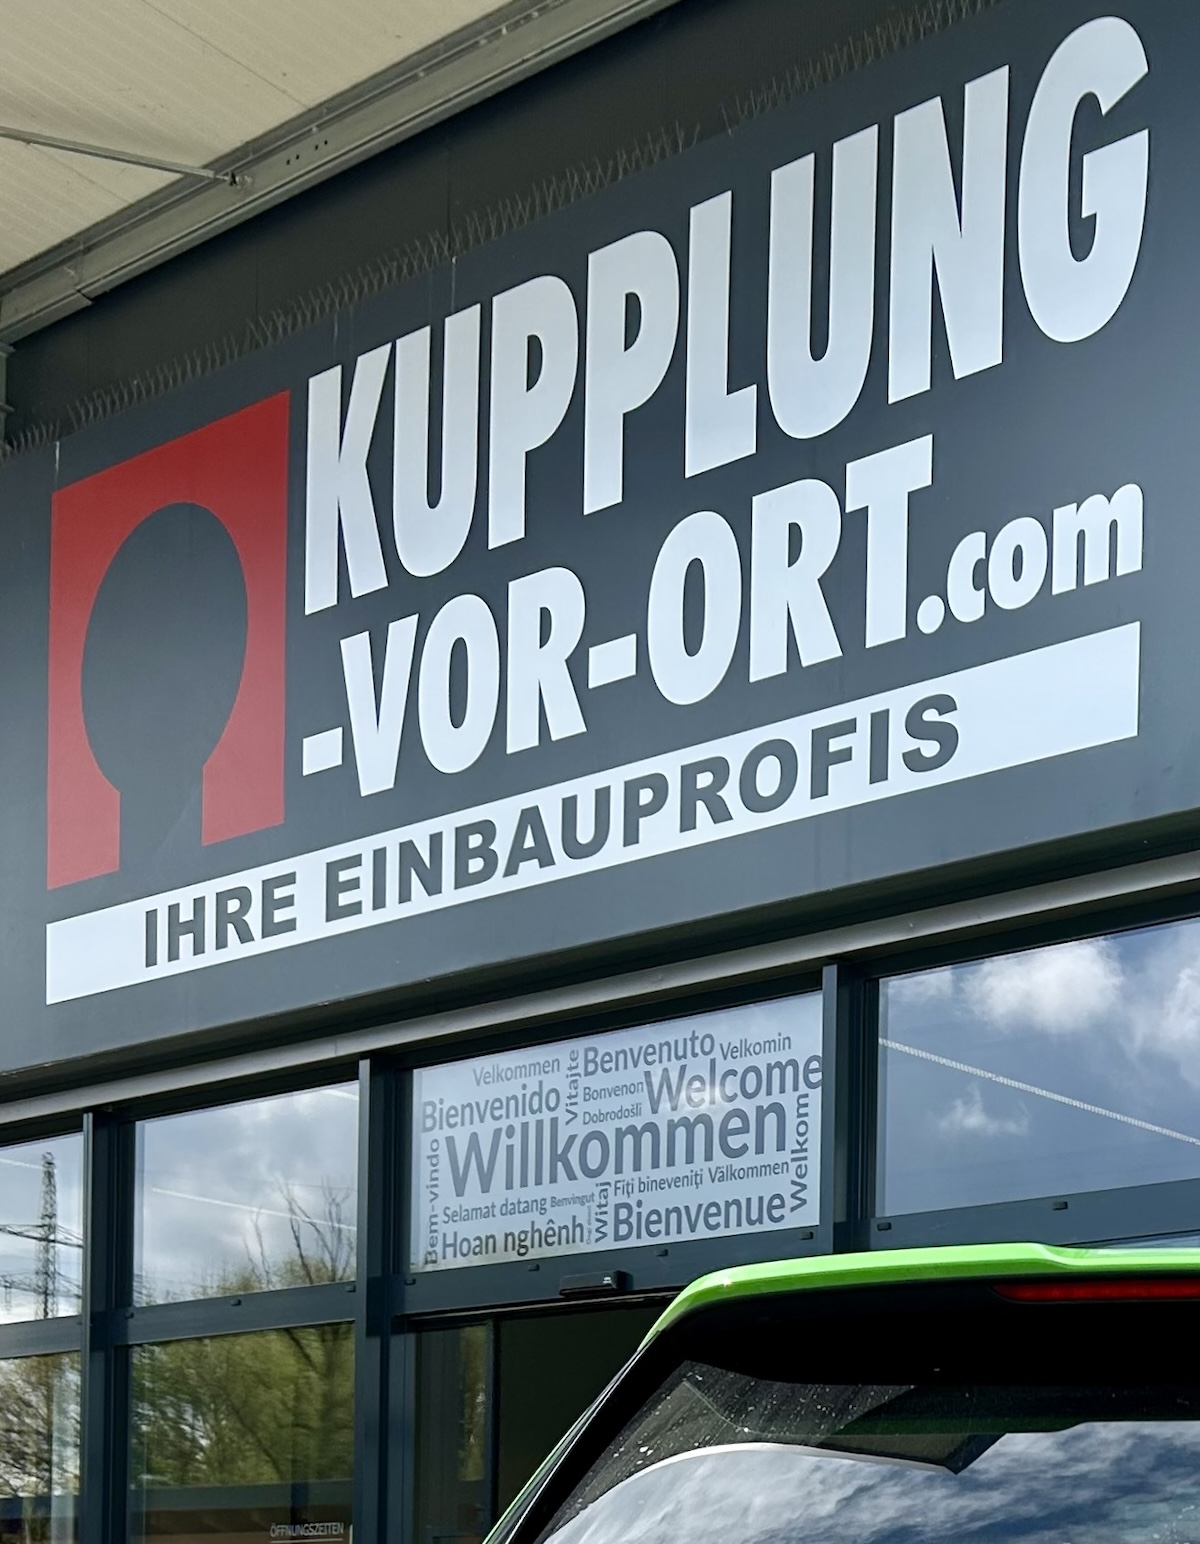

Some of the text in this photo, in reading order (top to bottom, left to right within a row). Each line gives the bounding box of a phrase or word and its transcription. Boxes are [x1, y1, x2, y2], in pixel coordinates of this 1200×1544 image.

[303, 15, 1150, 616] KUPPLUNG
[301, 434, 1144, 797] -VOR-ORT.com
[142, 692, 960, 968] IHRE EINBAUPROFIS
[584, 1030, 715, 1077] Benvenuto
[720, 1032, 792, 1060] Velkomin
[473, 1058, 560, 1087] Velkommen
[566, 1049, 582, 1126] Vitajte
[583, 1081, 644, 1101] Bonvenon
[644, 1055, 822, 1114] Welcome
[421, 1080, 560, 1133] Bienvenido
[582, 1103, 642, 1125] Dobrodošli
[445, 1102, 786, 1197] Willkommen
[708, 1161, 789, 1184] Välkommen
[790, 1094, 809, 1213] Welkom
[425, 1138, 440, 1265] Bem-vindo
[442, 1197, 547, 1224] Selamat datang
[594, 1182, 612, 1243] Witaj
[614, 1193, 786, 1242] Bienvenue
[442, 1231, 496, 1260] Hoan
[504, 1215, 584, 1256] nghênh
[270, 1523, 344, 1537] ÖFFNUNGSZEITEN
